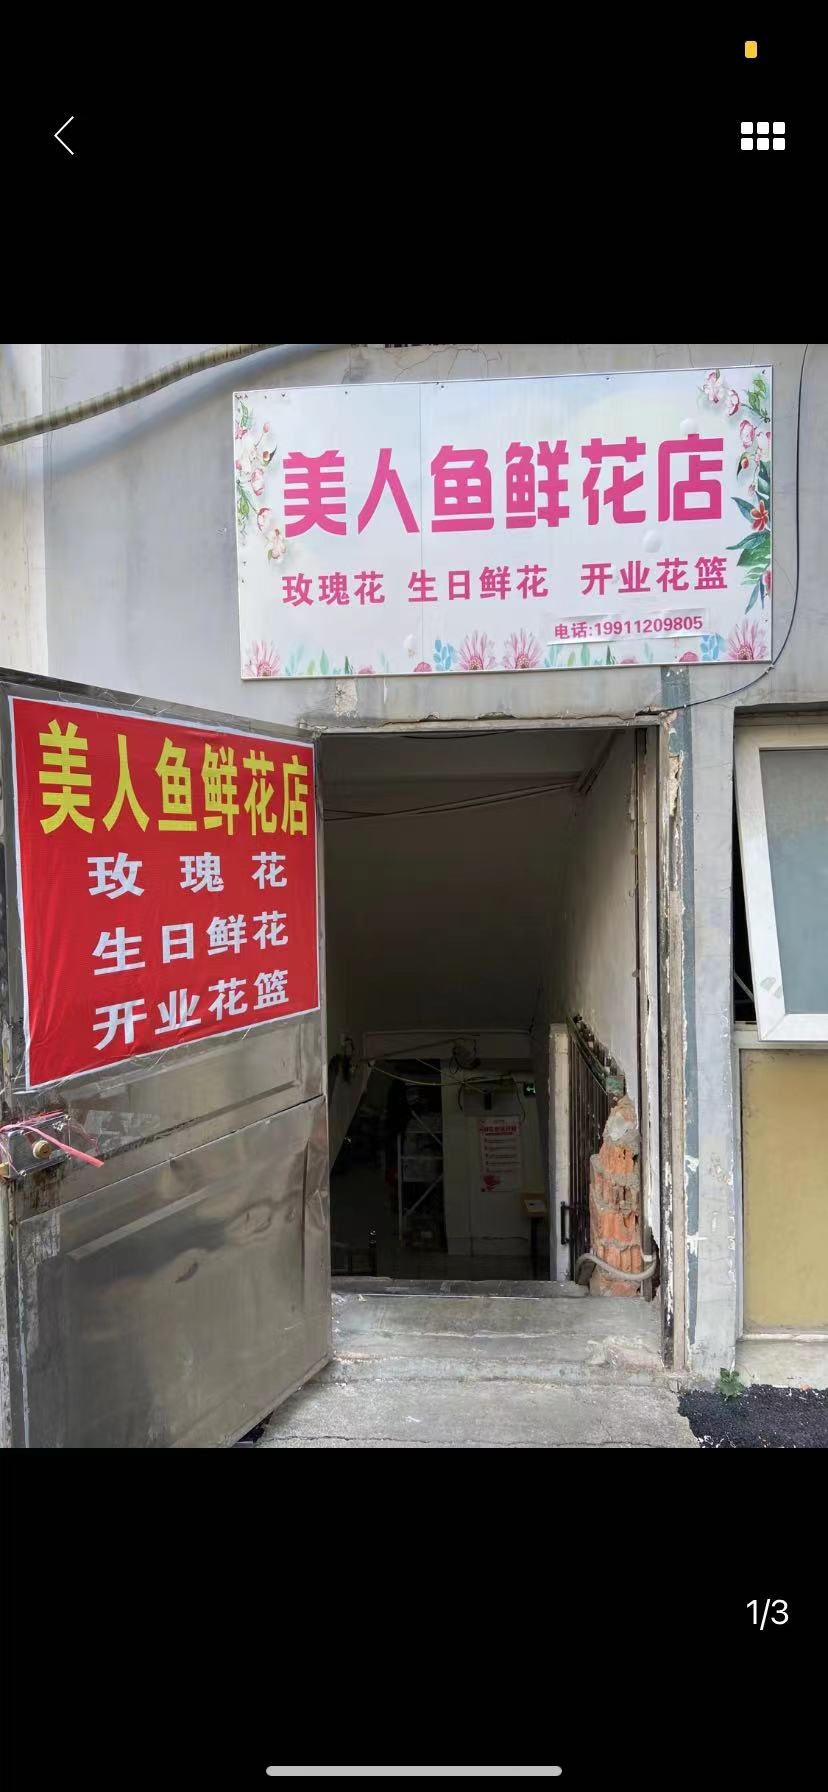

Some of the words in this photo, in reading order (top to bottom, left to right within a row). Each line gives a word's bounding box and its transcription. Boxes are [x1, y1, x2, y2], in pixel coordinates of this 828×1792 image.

[282, 433, 724, 537] 美人鱼鲜花店
[282, 570, 385, 606] 玫瑰花
[407, 564, 549, 603] 生日鲜花
[581, 556, 728, 596] 开业花篮
[39, 719, 309, 836] 美人鱼鲜花店
[87, 851, 288, 899] 玫瑰花
[92, 911, 289, 975] 生日鲜花
[93, 969, 290, 1051] 开业花篮
